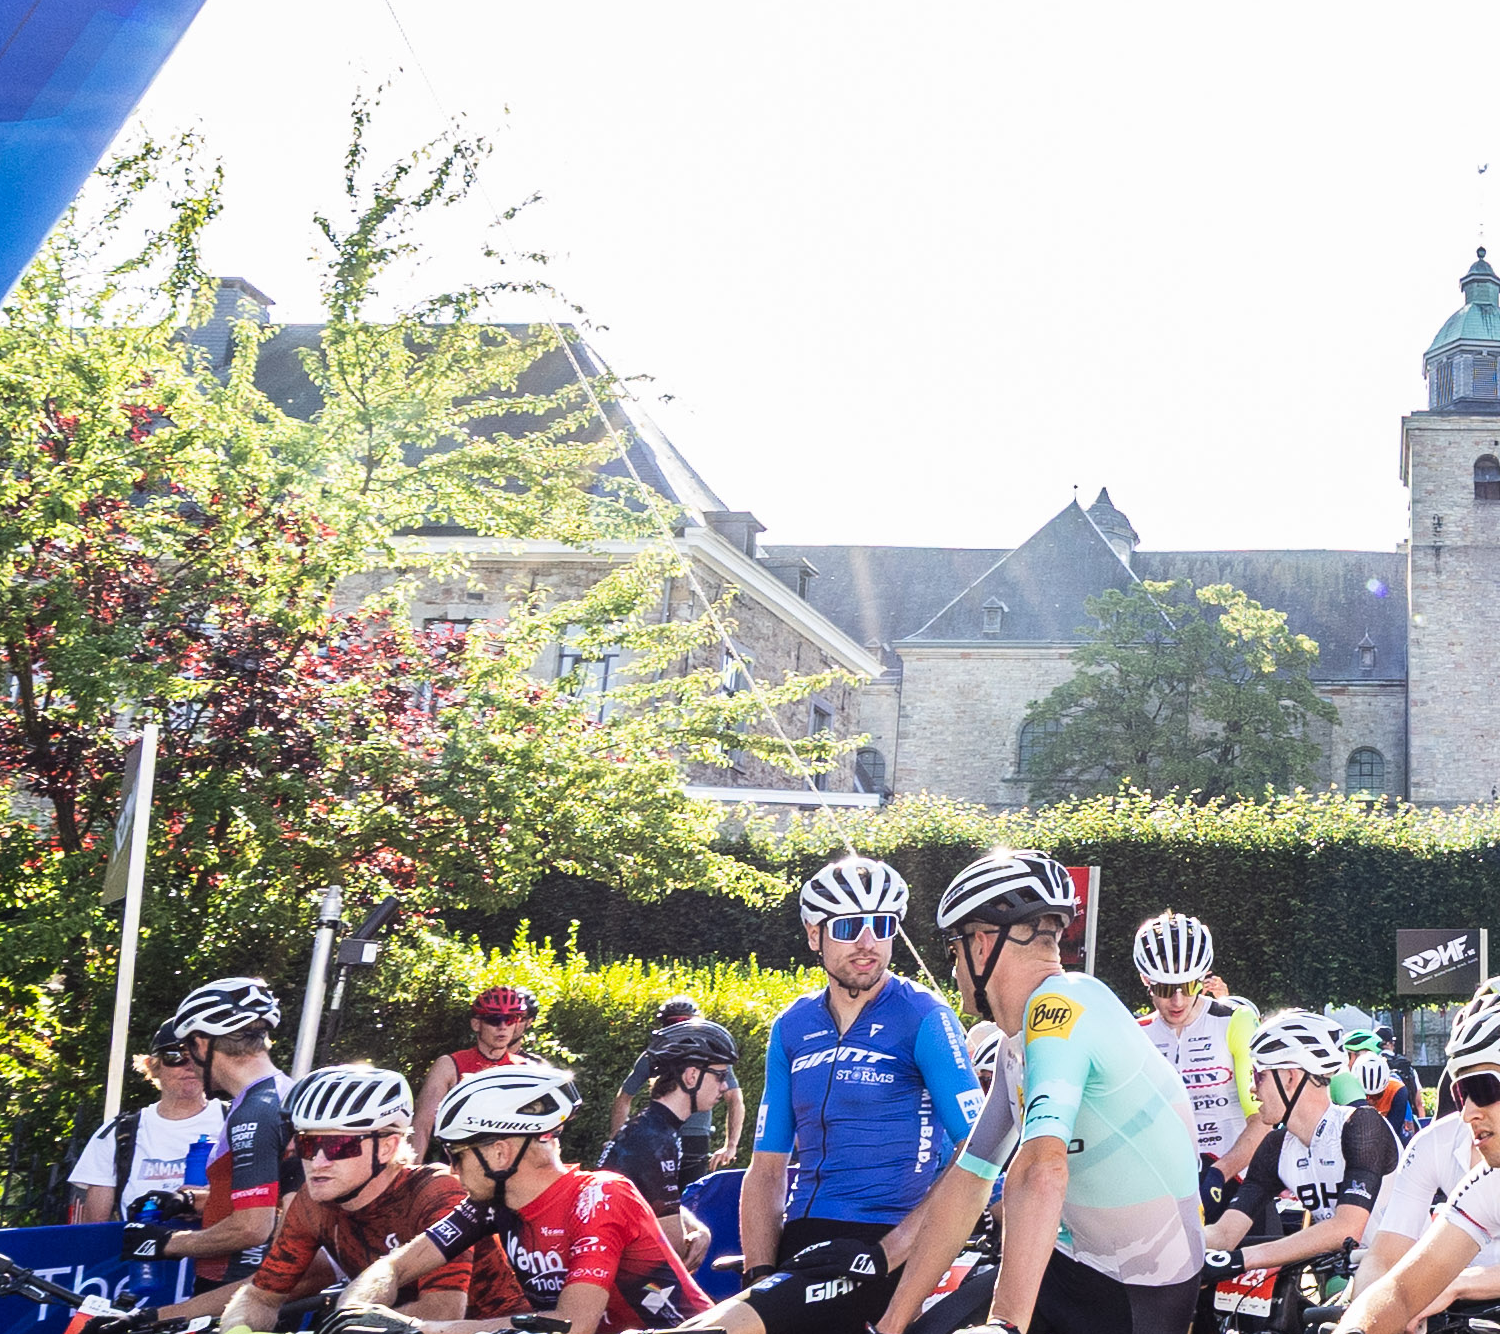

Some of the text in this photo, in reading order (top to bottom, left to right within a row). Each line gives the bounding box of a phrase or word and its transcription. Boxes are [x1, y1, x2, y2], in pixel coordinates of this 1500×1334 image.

[790, 1046, 898, 1075] GIANT
[463, 1115, 543, 1132] S-WORKS
[1297, 1183, 1341, 1211] BH
